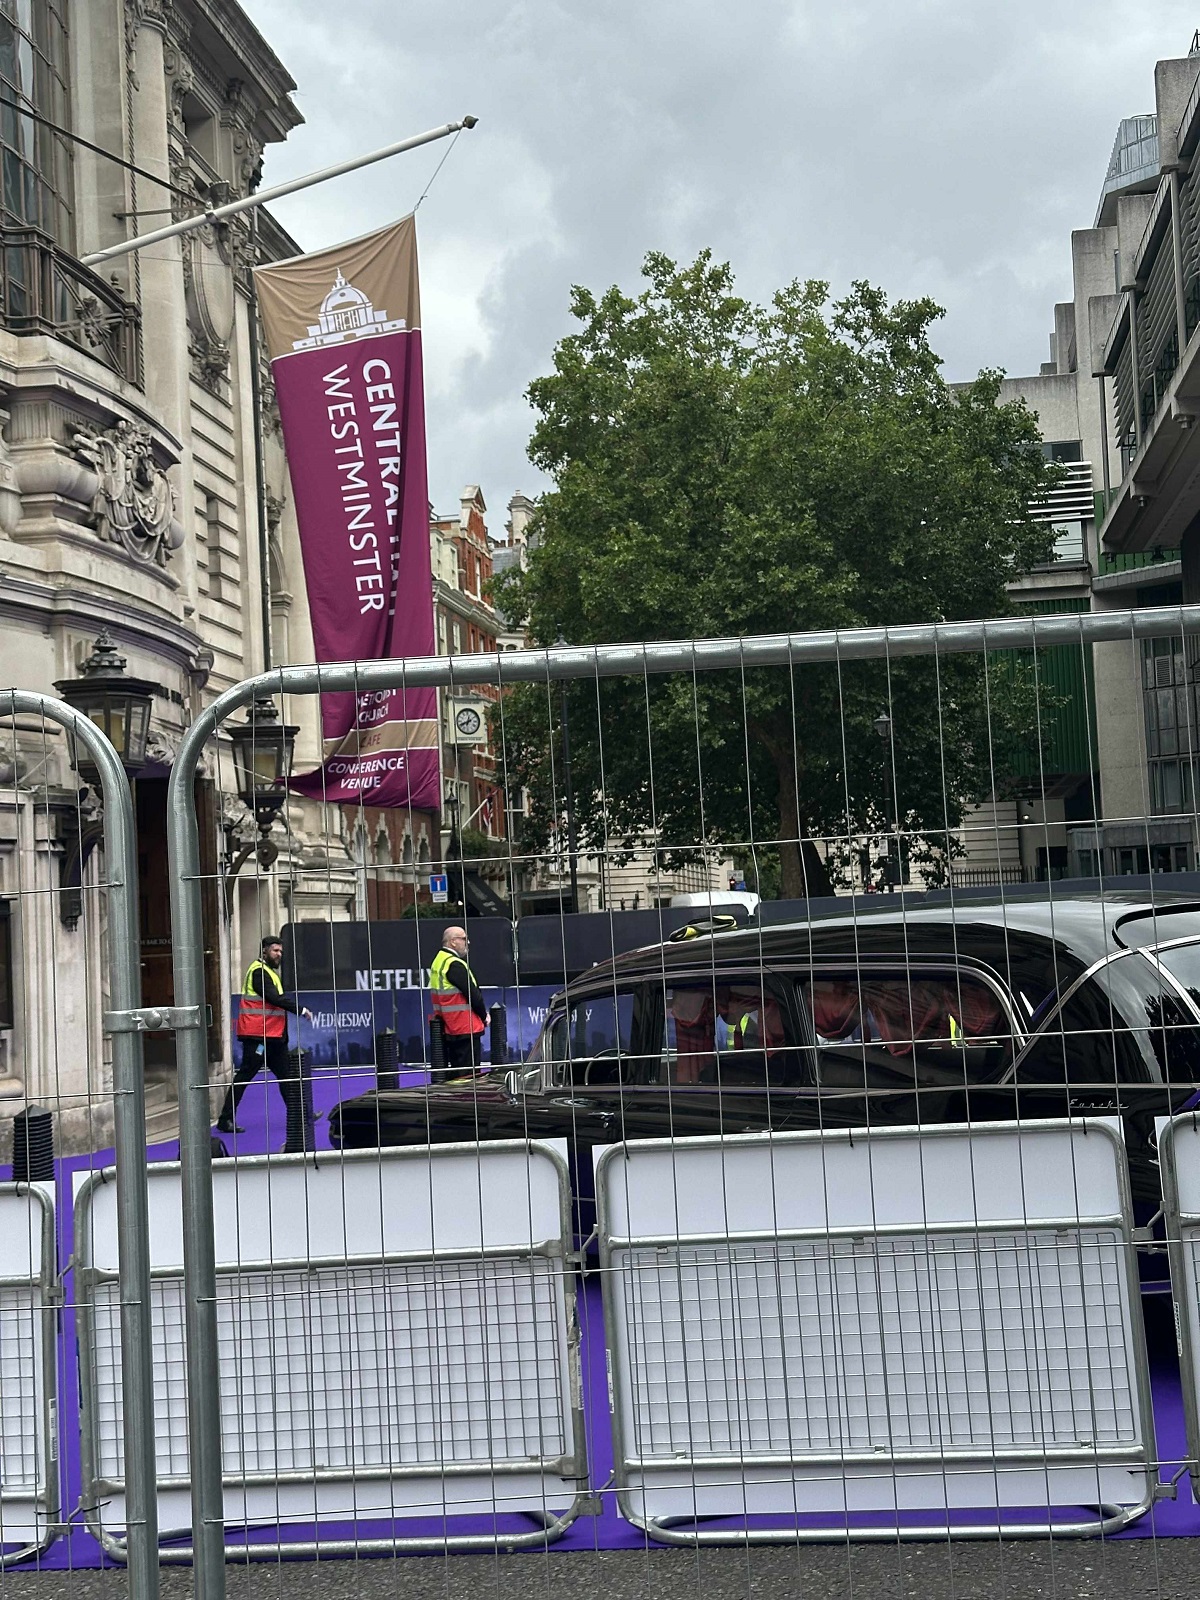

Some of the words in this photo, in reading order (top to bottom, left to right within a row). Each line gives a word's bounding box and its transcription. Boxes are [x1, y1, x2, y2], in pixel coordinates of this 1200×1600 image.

[322, 363, 385, 615] WESTMINSTER
[327, 756, 405, 775] CONFERENCE
[340, 776, 381, 789] VENUE
[310, 1011, 372, 1029] WEDNESDAY
[1069, 1098, 1130, 1109] Eureka
